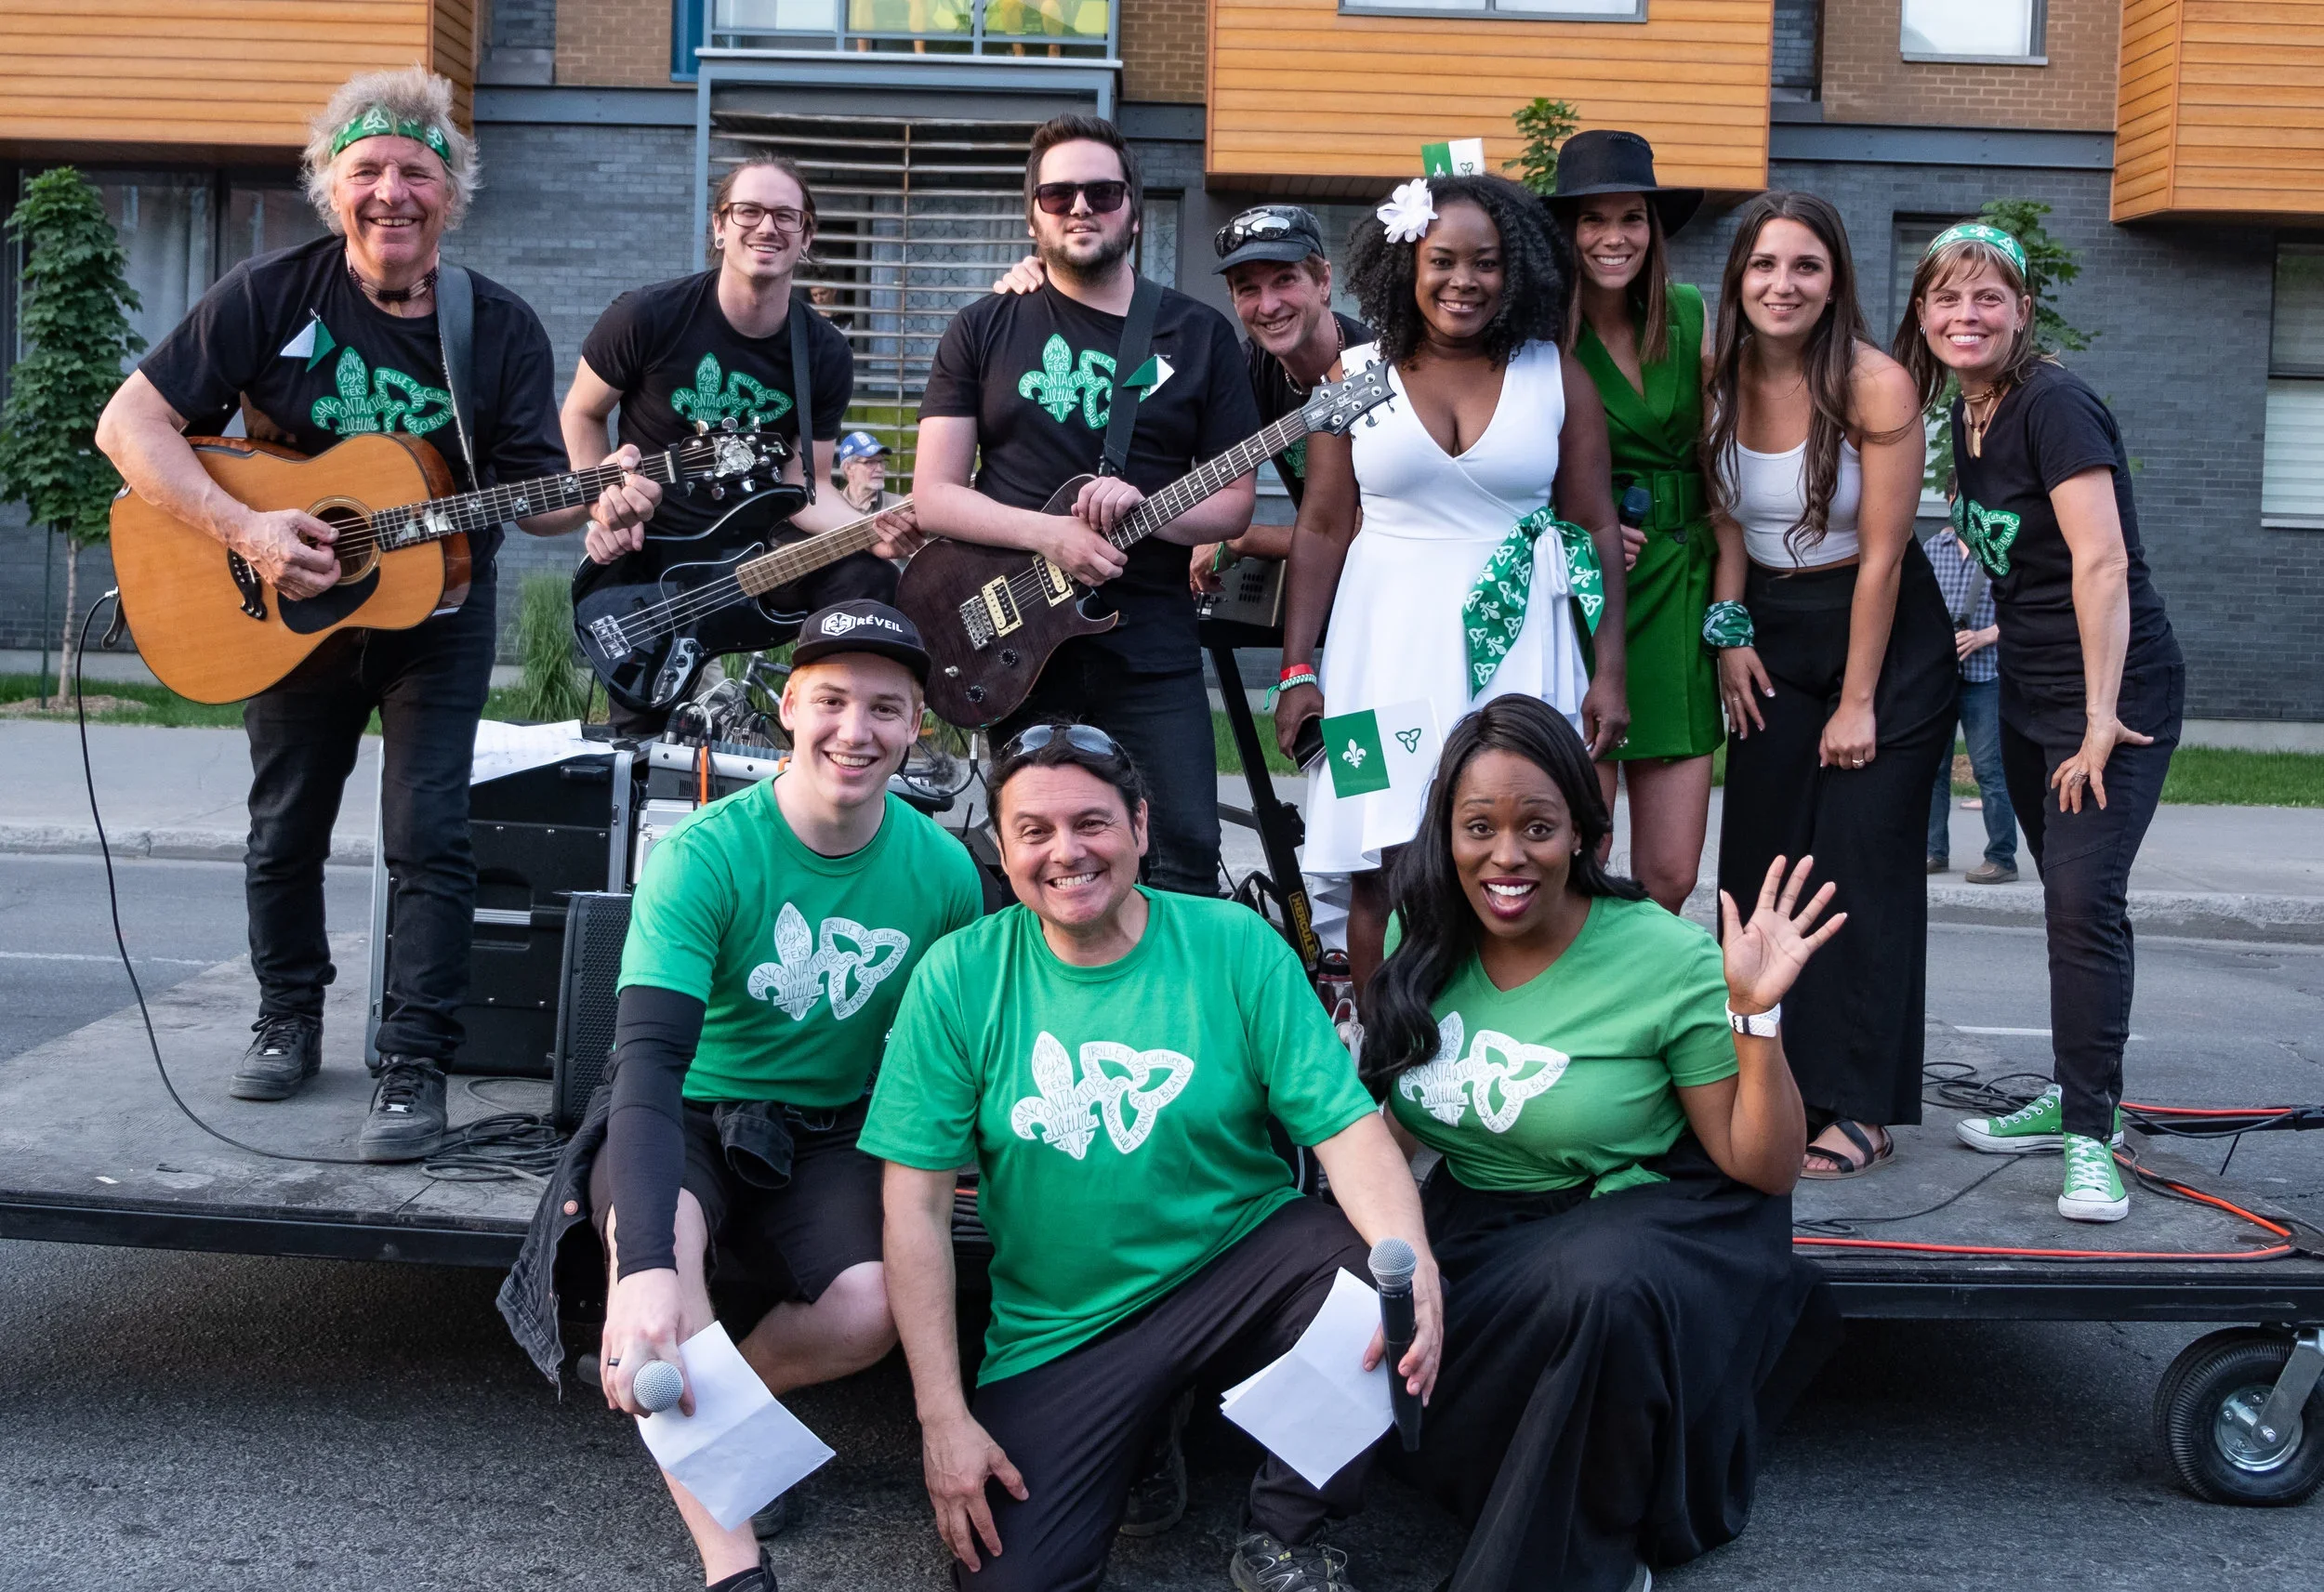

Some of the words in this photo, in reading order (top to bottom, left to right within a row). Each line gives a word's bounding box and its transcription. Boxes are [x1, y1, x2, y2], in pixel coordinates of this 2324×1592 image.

[1086, 352, 1115, 368] TRILLE
[377, 369, 412, 388] TRILLE
[1043, 372, 1086, 389] ONTARIO
[339, 394, 384, 418] ONTARIO
[693, 392, 732, 409] ONTARIO
[856, 614, 904, 633] RÉVEIL
[822, 921, 859, 937] TRILLE
[1292, 894, 1317, 962] HERCULES
[780, 945, 810, 960] FIERS
[881, 942, 907, 976] BLANC
[753, 966, 782, 997] BLANC
[781, 952, 828, 986] ONTARIO
[849, 969, 881, 1010] FRANCO
[1082, 1046, 1125, 1059] TRILLE
[1040, 1076, 1072, 1092] FIERS
[1158, 1062, 1192, 1100] BLANC
[1423, 1060, 1473, 1087] ONTARIO
[1043, 1080, 1097, 1121] ONTARIO
[1015, 1102, 1045, 1136] BLANC
[1131, 1096, 1161, 1142] FRANCO
